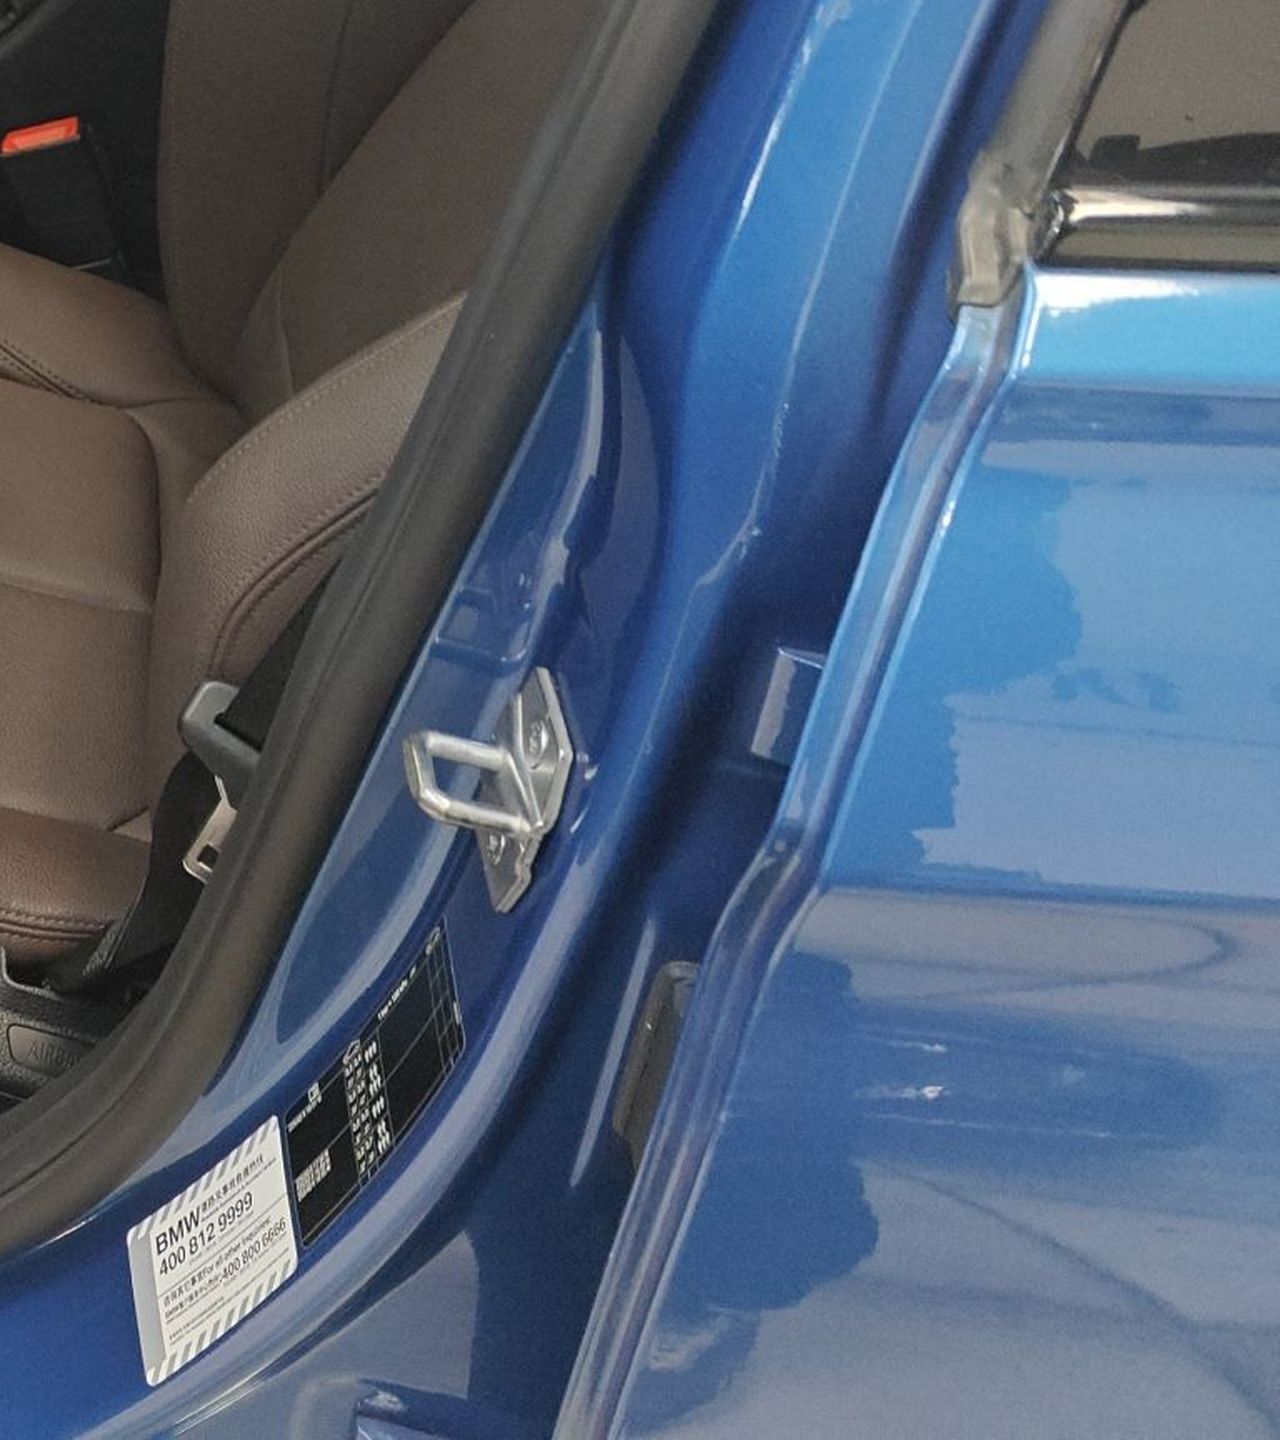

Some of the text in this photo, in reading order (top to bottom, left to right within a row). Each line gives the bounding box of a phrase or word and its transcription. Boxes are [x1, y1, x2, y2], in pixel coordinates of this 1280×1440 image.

[156, 1206, 200, 1255] BMW
[160, 1246, 186, 1275] 400
[189, 1222, 216, 1255] 812
[218, 1191, 252, 1232] 9999
[222, 1257, 241, 1279] 400
[241, 1240, 260, 1264] 800
